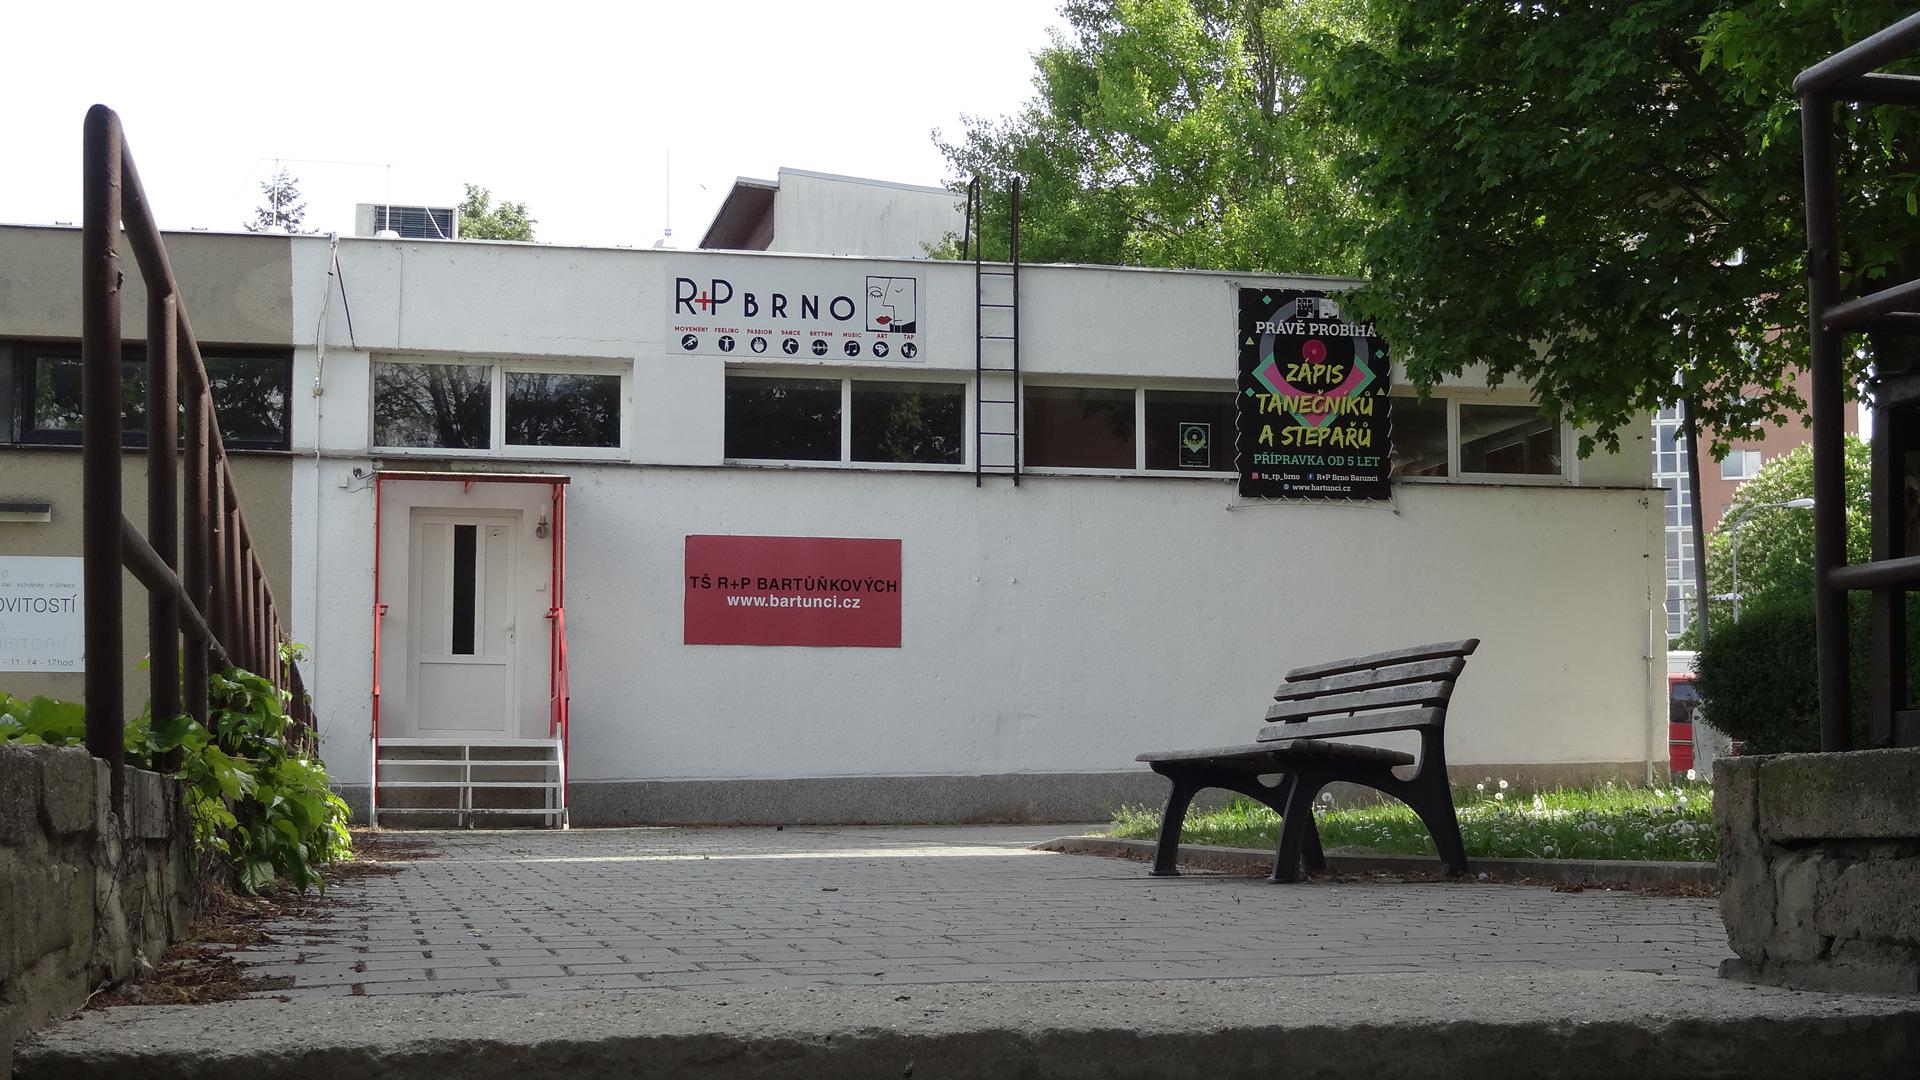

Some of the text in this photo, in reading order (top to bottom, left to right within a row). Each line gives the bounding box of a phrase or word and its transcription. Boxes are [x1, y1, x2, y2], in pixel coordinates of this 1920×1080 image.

[675, 277, 855, 321] R+P BRNO
[1255, 320, 1377, 338] PRÁVĚ PROBÍHÁ
[1286, 357, 1344, 385] ZÁPIS
[1255, 389, 1374, 417] TANEČNÍKŮ
[1258, 421, 1372, 449] A STEPAŘŮ
[1253, 452, 1381, 467] PŘÍPRAVKA OD 5 LET
[1261, 472, 1301, 481] ts_rp_brno
[1292, 484, 1351, 492] www.bartunci.cz
[689, 574, 897, 593] TŠ R+P BARTŮŇKOVÝCH
[727, 594, 861, 609] www.bartunci.cz
